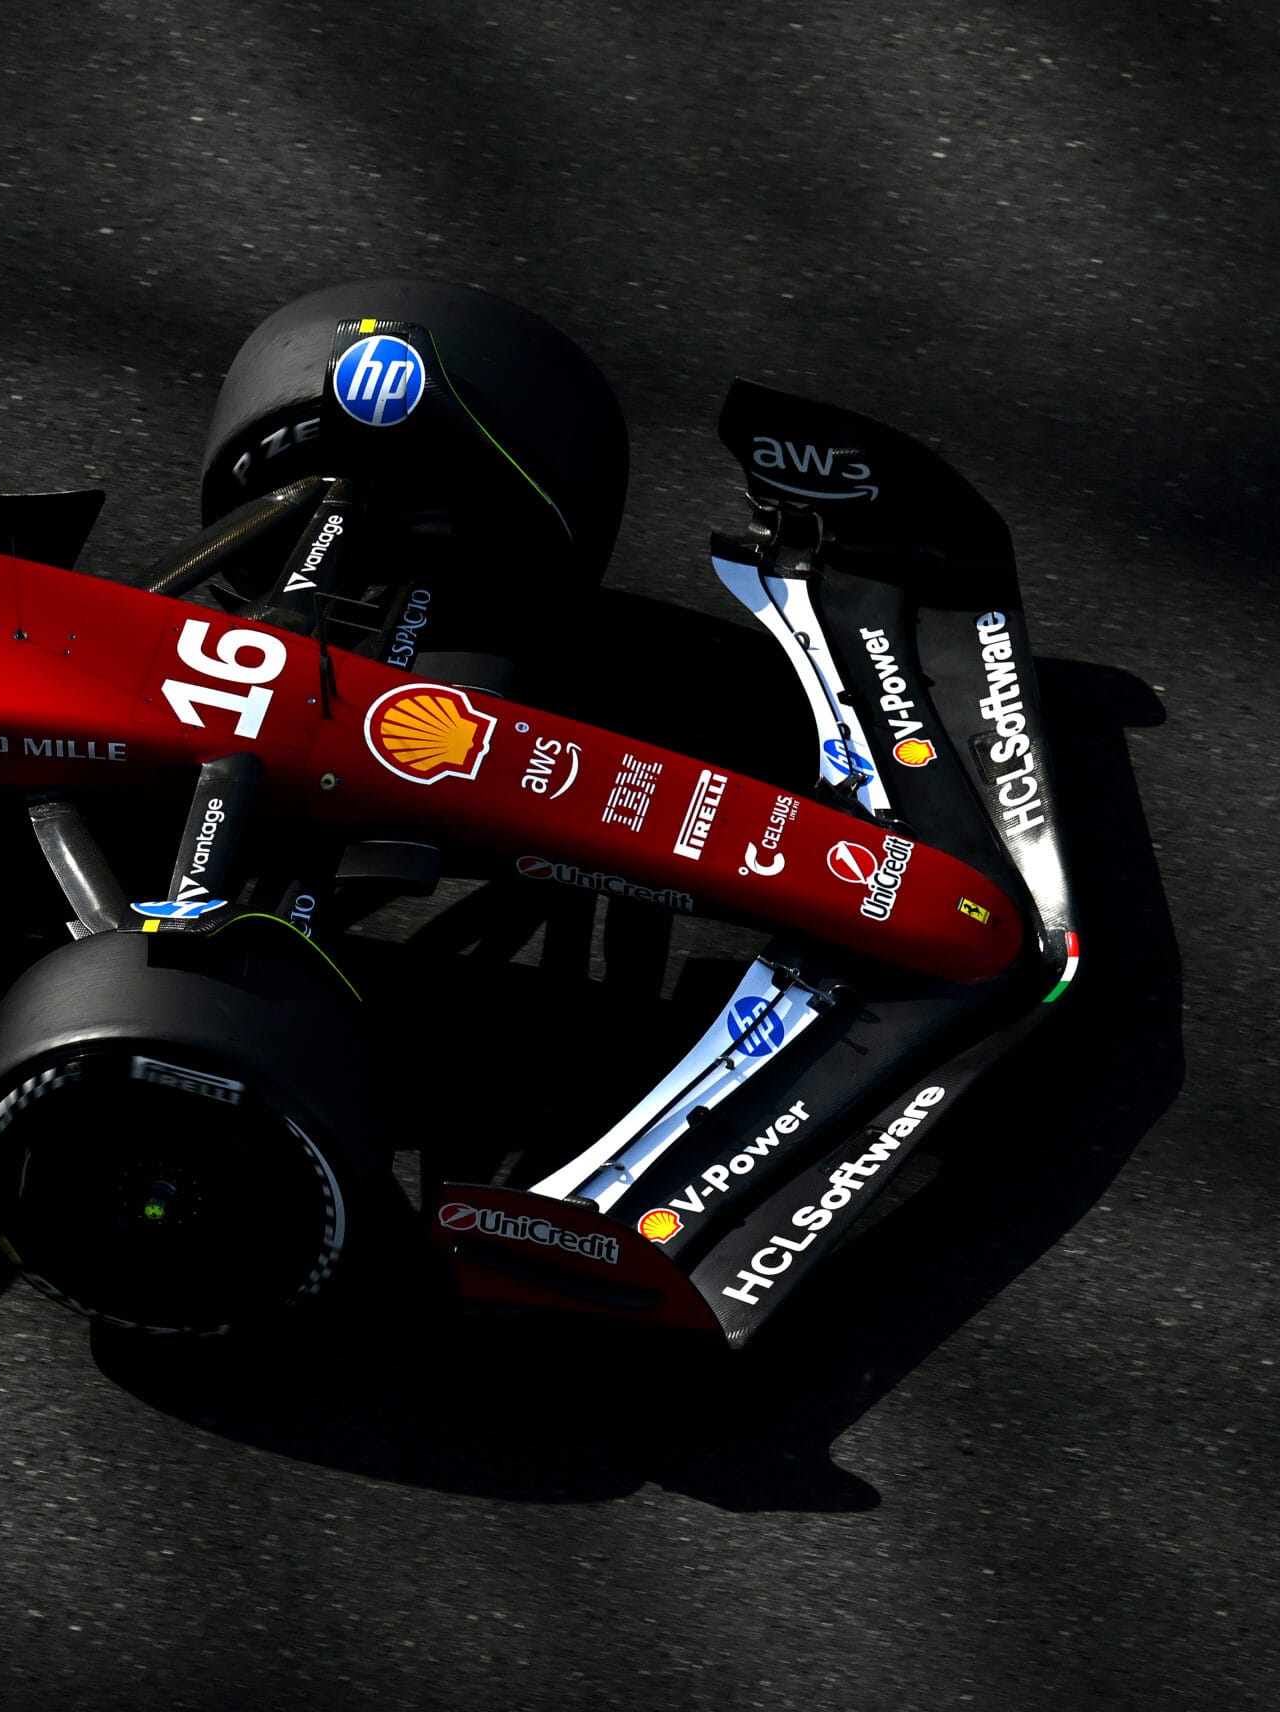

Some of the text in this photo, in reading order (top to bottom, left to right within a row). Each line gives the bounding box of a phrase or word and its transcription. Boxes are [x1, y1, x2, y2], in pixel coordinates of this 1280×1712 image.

[346, 337, 416, 426] hp
[751, 434, 872, 481] aws
[302, 513, 344, 573] vantage
[386, 588, 431, 669] ESPACIO
[161, 618, 288, 740] 16
[858, 626, 924, 739] V-Power
[23, 737, 128, 763] MILLE
[973, 609, 1046, 837] HCLSoftware
[519, 736, 564, 796] aws
[601, 752, 664, 833] IBM
[189, 797, 225, 876] vantage
[672, 768, 729, 861] PIRELLI
[761, 794, 793, 850] CELSIUS
[554, 861, 695, 912] UniCredit
[859, 835, 915, 922] UniCredit
[730, 996, 784, 1057] hp
[668, 1099, 812, 1218] V-Power
[721, 1084, 949, 1306] HCLSoftware
[475, 1208, 621, 1265] UniCredit
